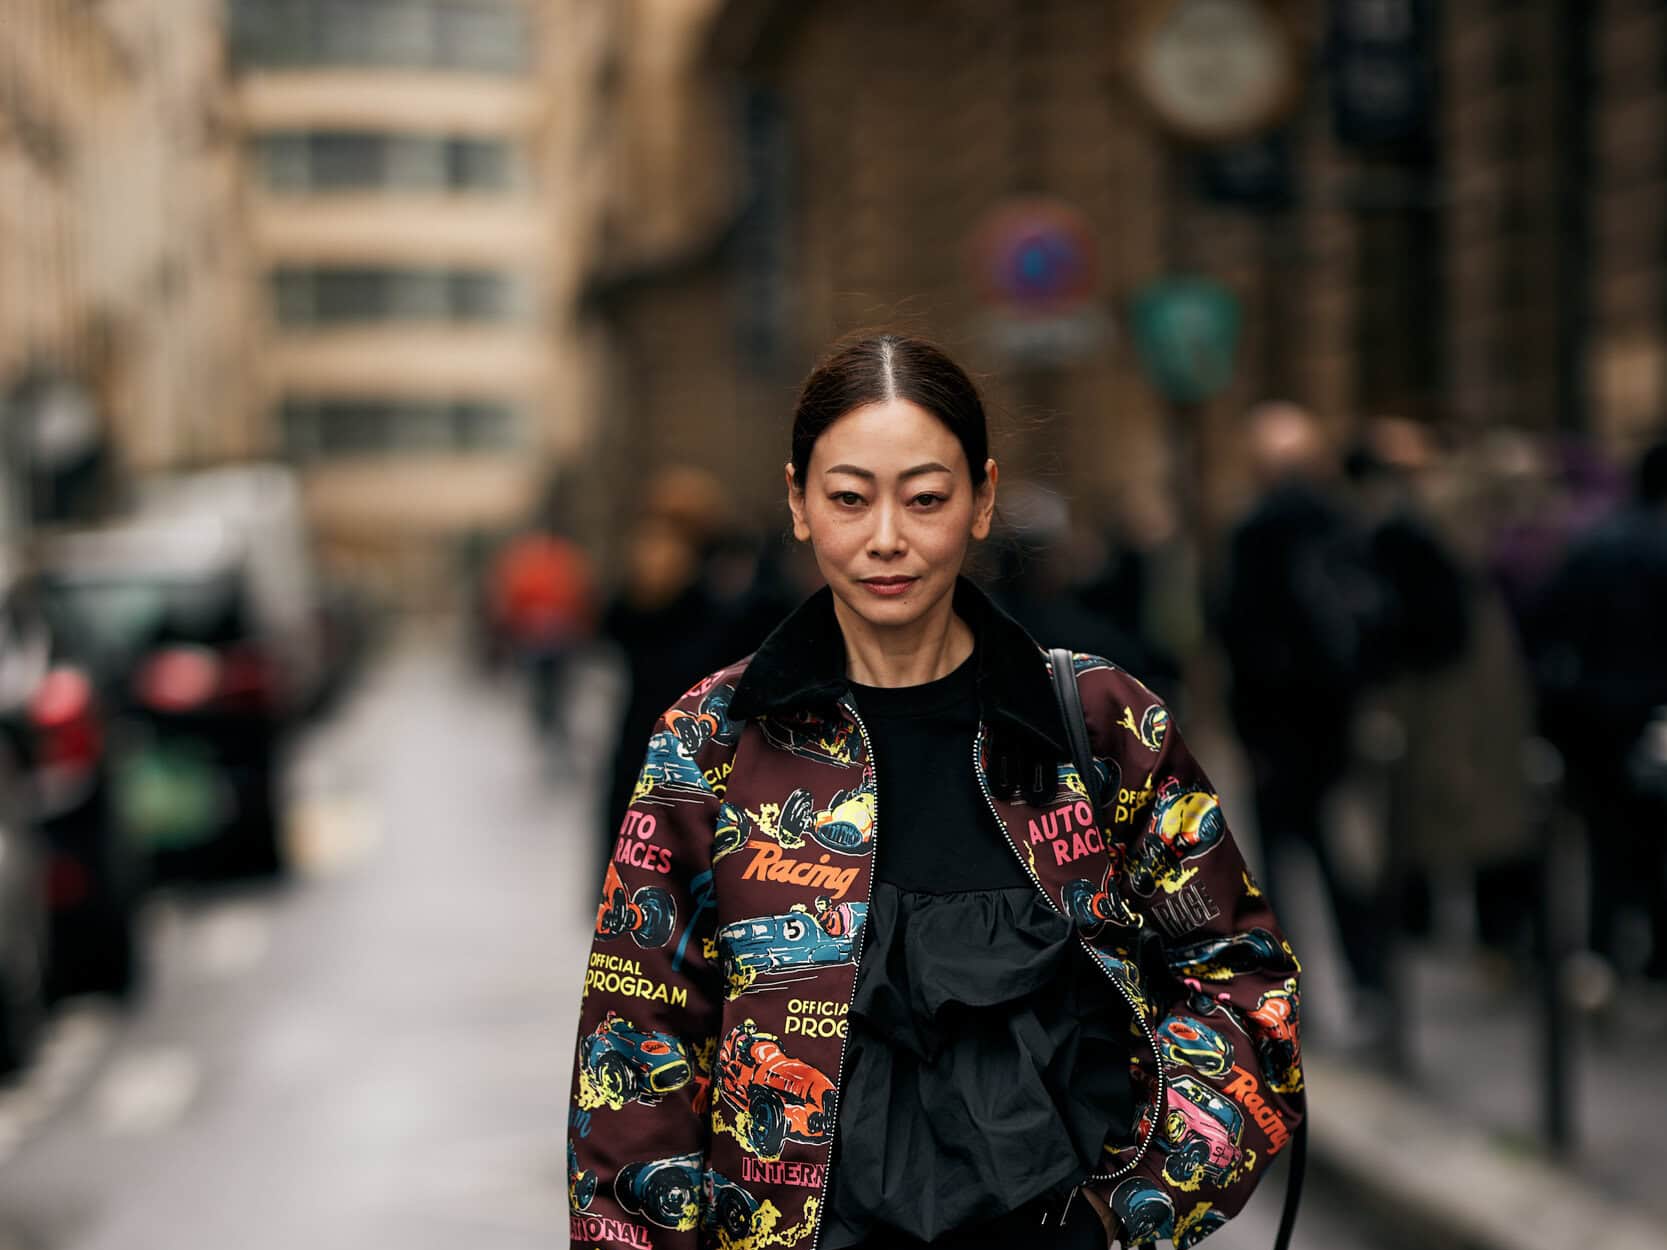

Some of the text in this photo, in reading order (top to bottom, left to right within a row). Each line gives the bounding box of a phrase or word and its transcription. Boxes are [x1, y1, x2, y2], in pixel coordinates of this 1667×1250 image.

[1028, 801, 1093, 845] AUTO
[614, 837, 673, 874] RACES
[741, 840, 860, 899] Racing
[786, 919, 801, 939] 5
[589, 953, 643, 976] OFFICIAL
[586, 969, 688, 1008] PROGRAM
[1222, 1064, 1291, 1157] Racing
